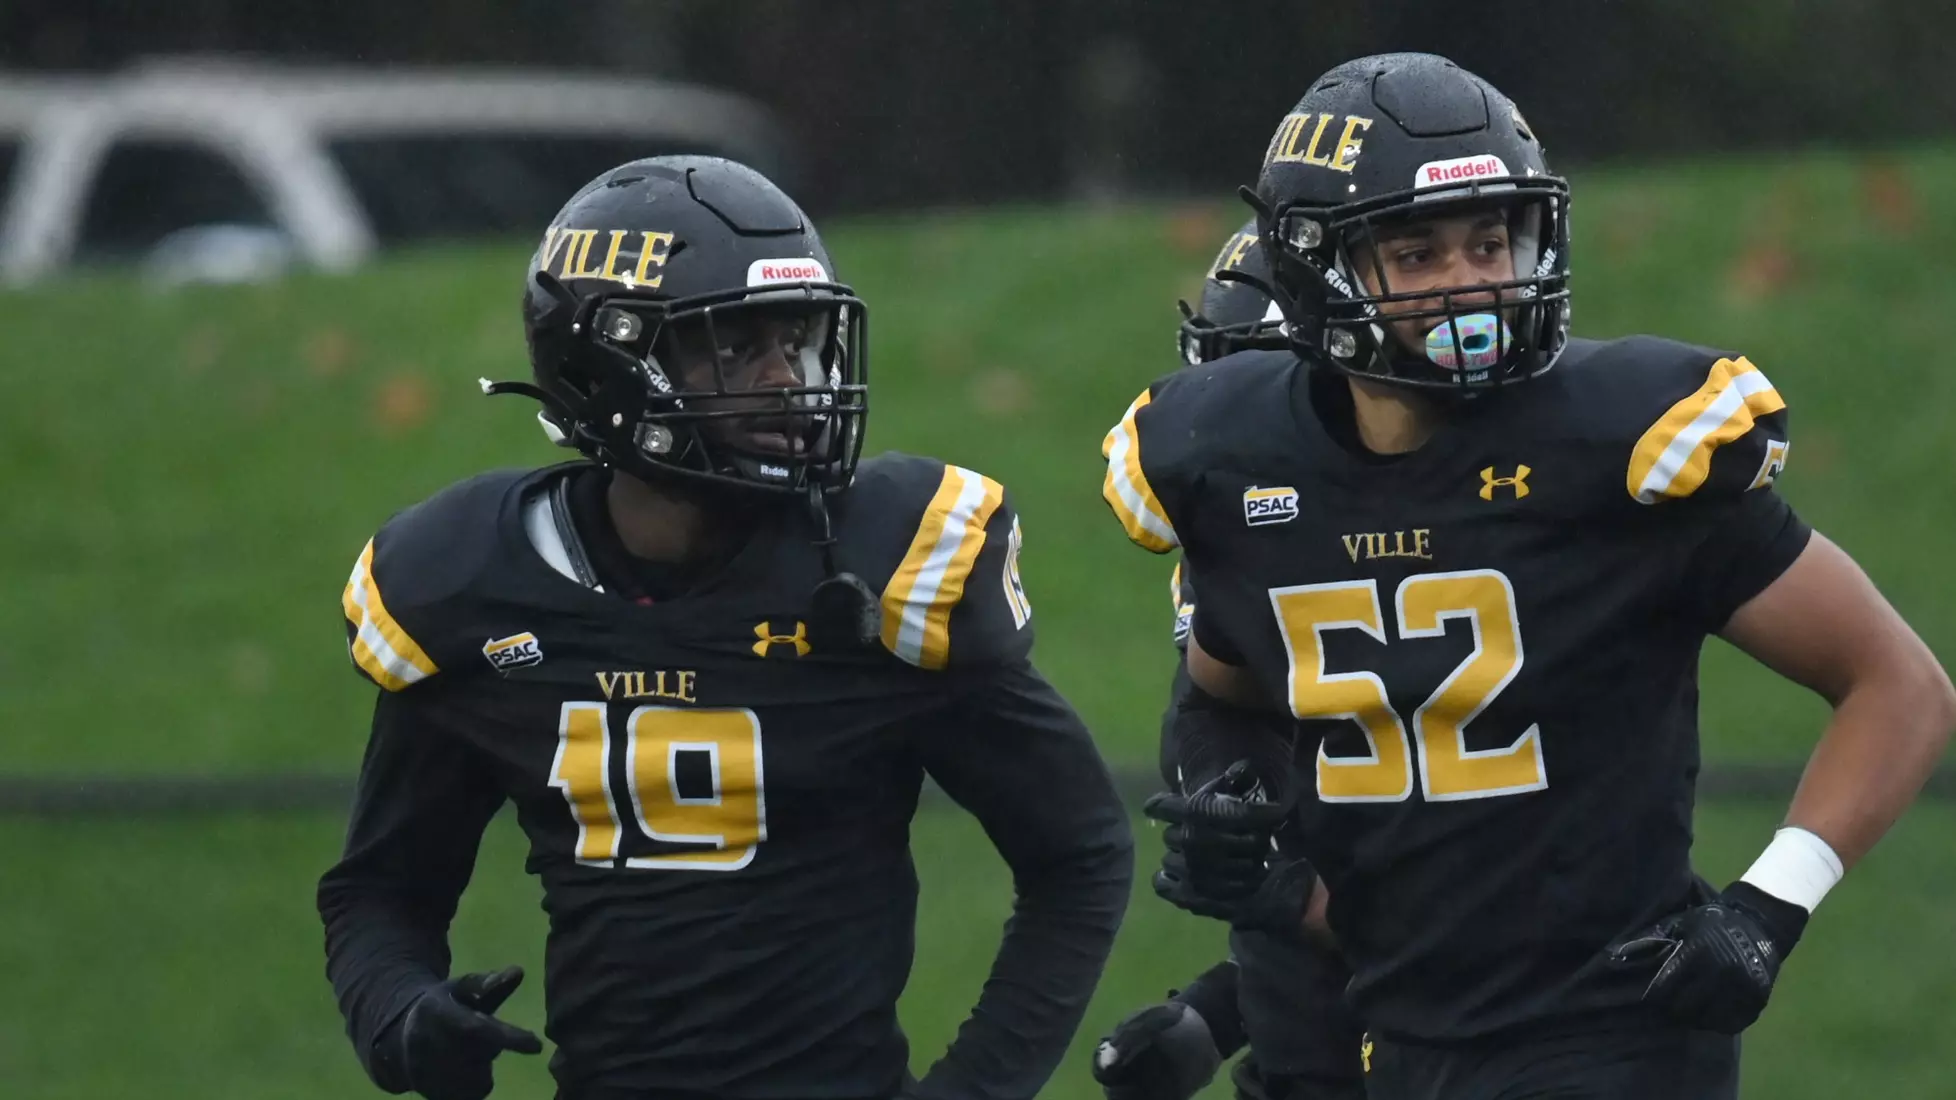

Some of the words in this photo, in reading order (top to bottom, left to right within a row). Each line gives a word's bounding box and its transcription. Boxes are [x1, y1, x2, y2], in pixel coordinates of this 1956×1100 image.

[1246, 496, 1295, 516] PSAC
[1341, 528, 1433, 564] VILLE
[488, 641, 538, 666] PSAC
[595, 670, 697, 703] VILLE
[1268, 569, 1548, 803] 52
[547, 700, 768, 872] 19
